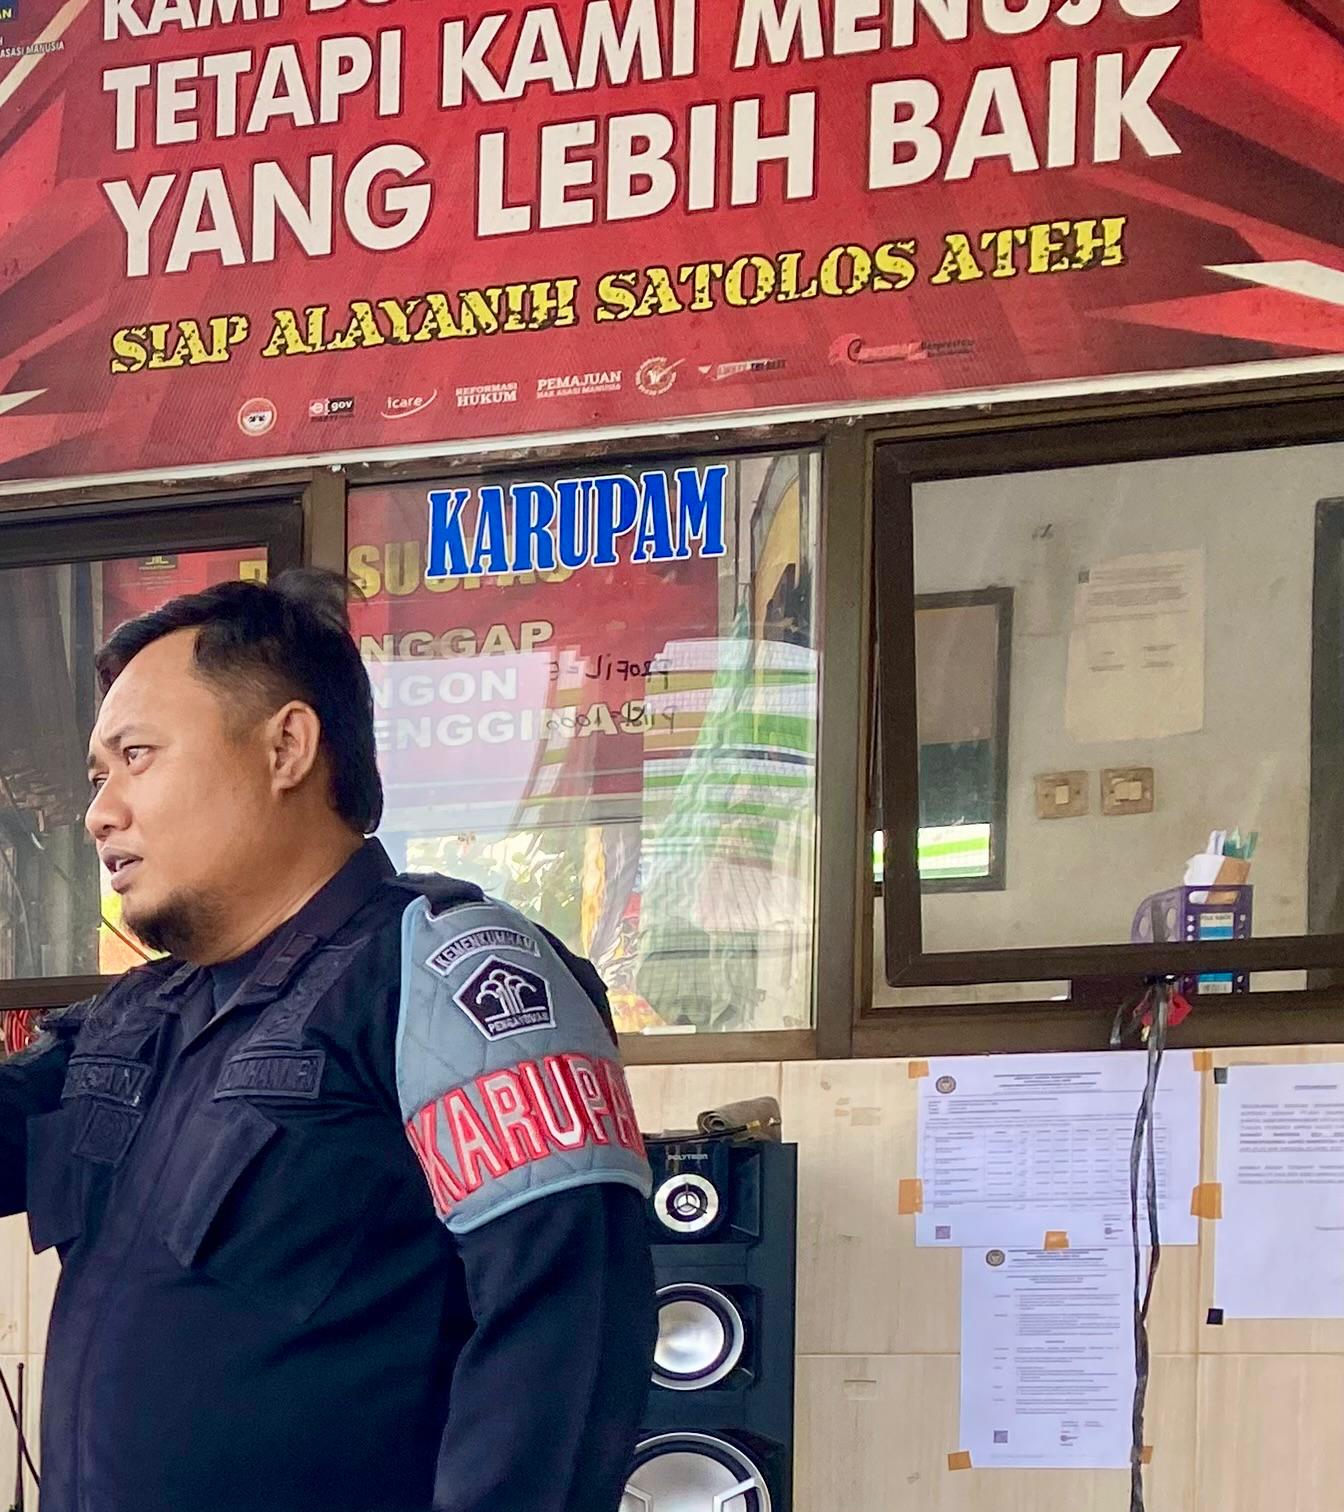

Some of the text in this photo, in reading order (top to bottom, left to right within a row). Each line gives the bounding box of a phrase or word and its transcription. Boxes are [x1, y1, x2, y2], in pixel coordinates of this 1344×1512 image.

[0, 47, 25, 59] ASASI
[26, 40, 65, 56] MANUSIA
[102, 30, 402, 150] TETAPI
[441, 0, 696, 108] KAMI
[102, 45, 1182, 277] YANG LEBIH BAIK
[111, 215, 1128, 374] SIAP ALAYANIH SATOLOS ATEH
[387, 395, 424, 409] icare
[457, 390, 517, 407] HUKUM
[537, 370, 623, 391] PEMAJUAN
[426, 465, 729, 578] KARUPAM
